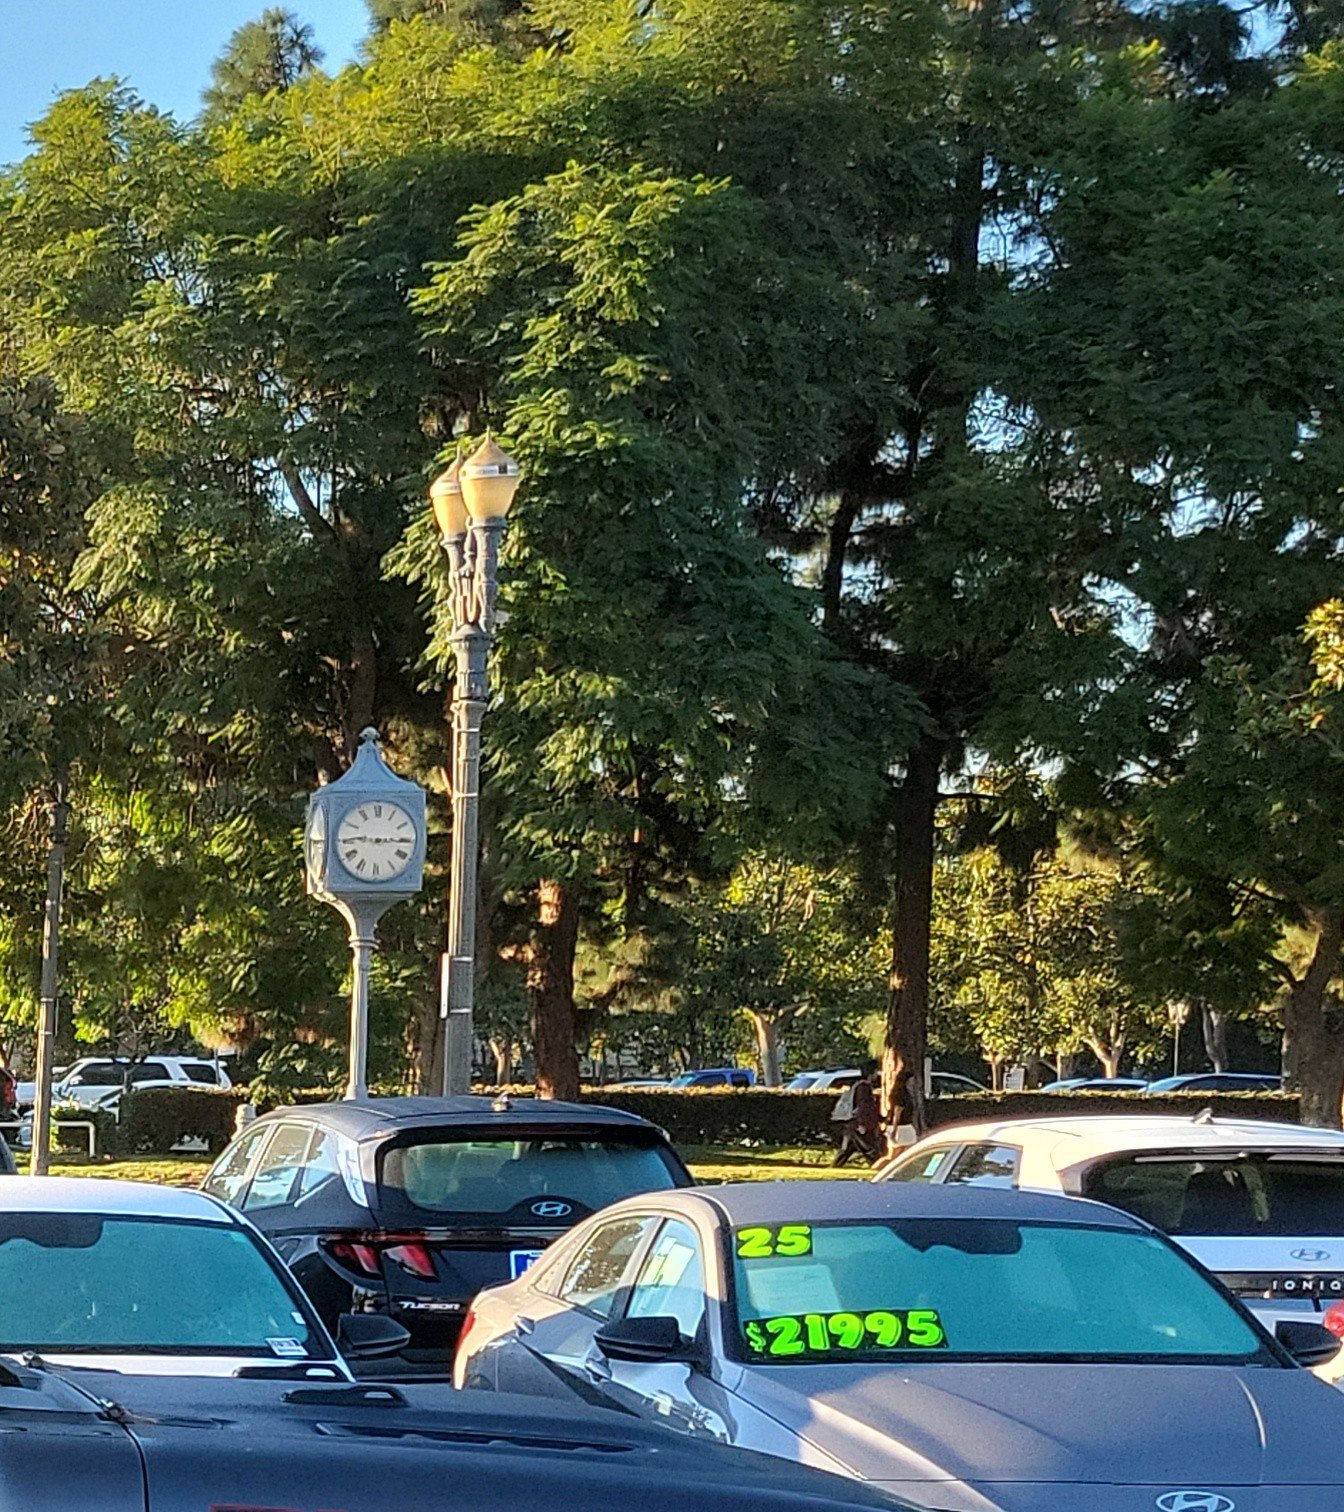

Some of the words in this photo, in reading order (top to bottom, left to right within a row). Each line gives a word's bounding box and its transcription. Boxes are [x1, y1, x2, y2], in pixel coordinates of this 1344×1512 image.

[737, 1225, 811, 1257] 25
[1272, 1280, 1342, 1291] IONIQ
[399, 1301, 461, 1311] TUCSON
[746, 1309, 943, 1356] $21995
